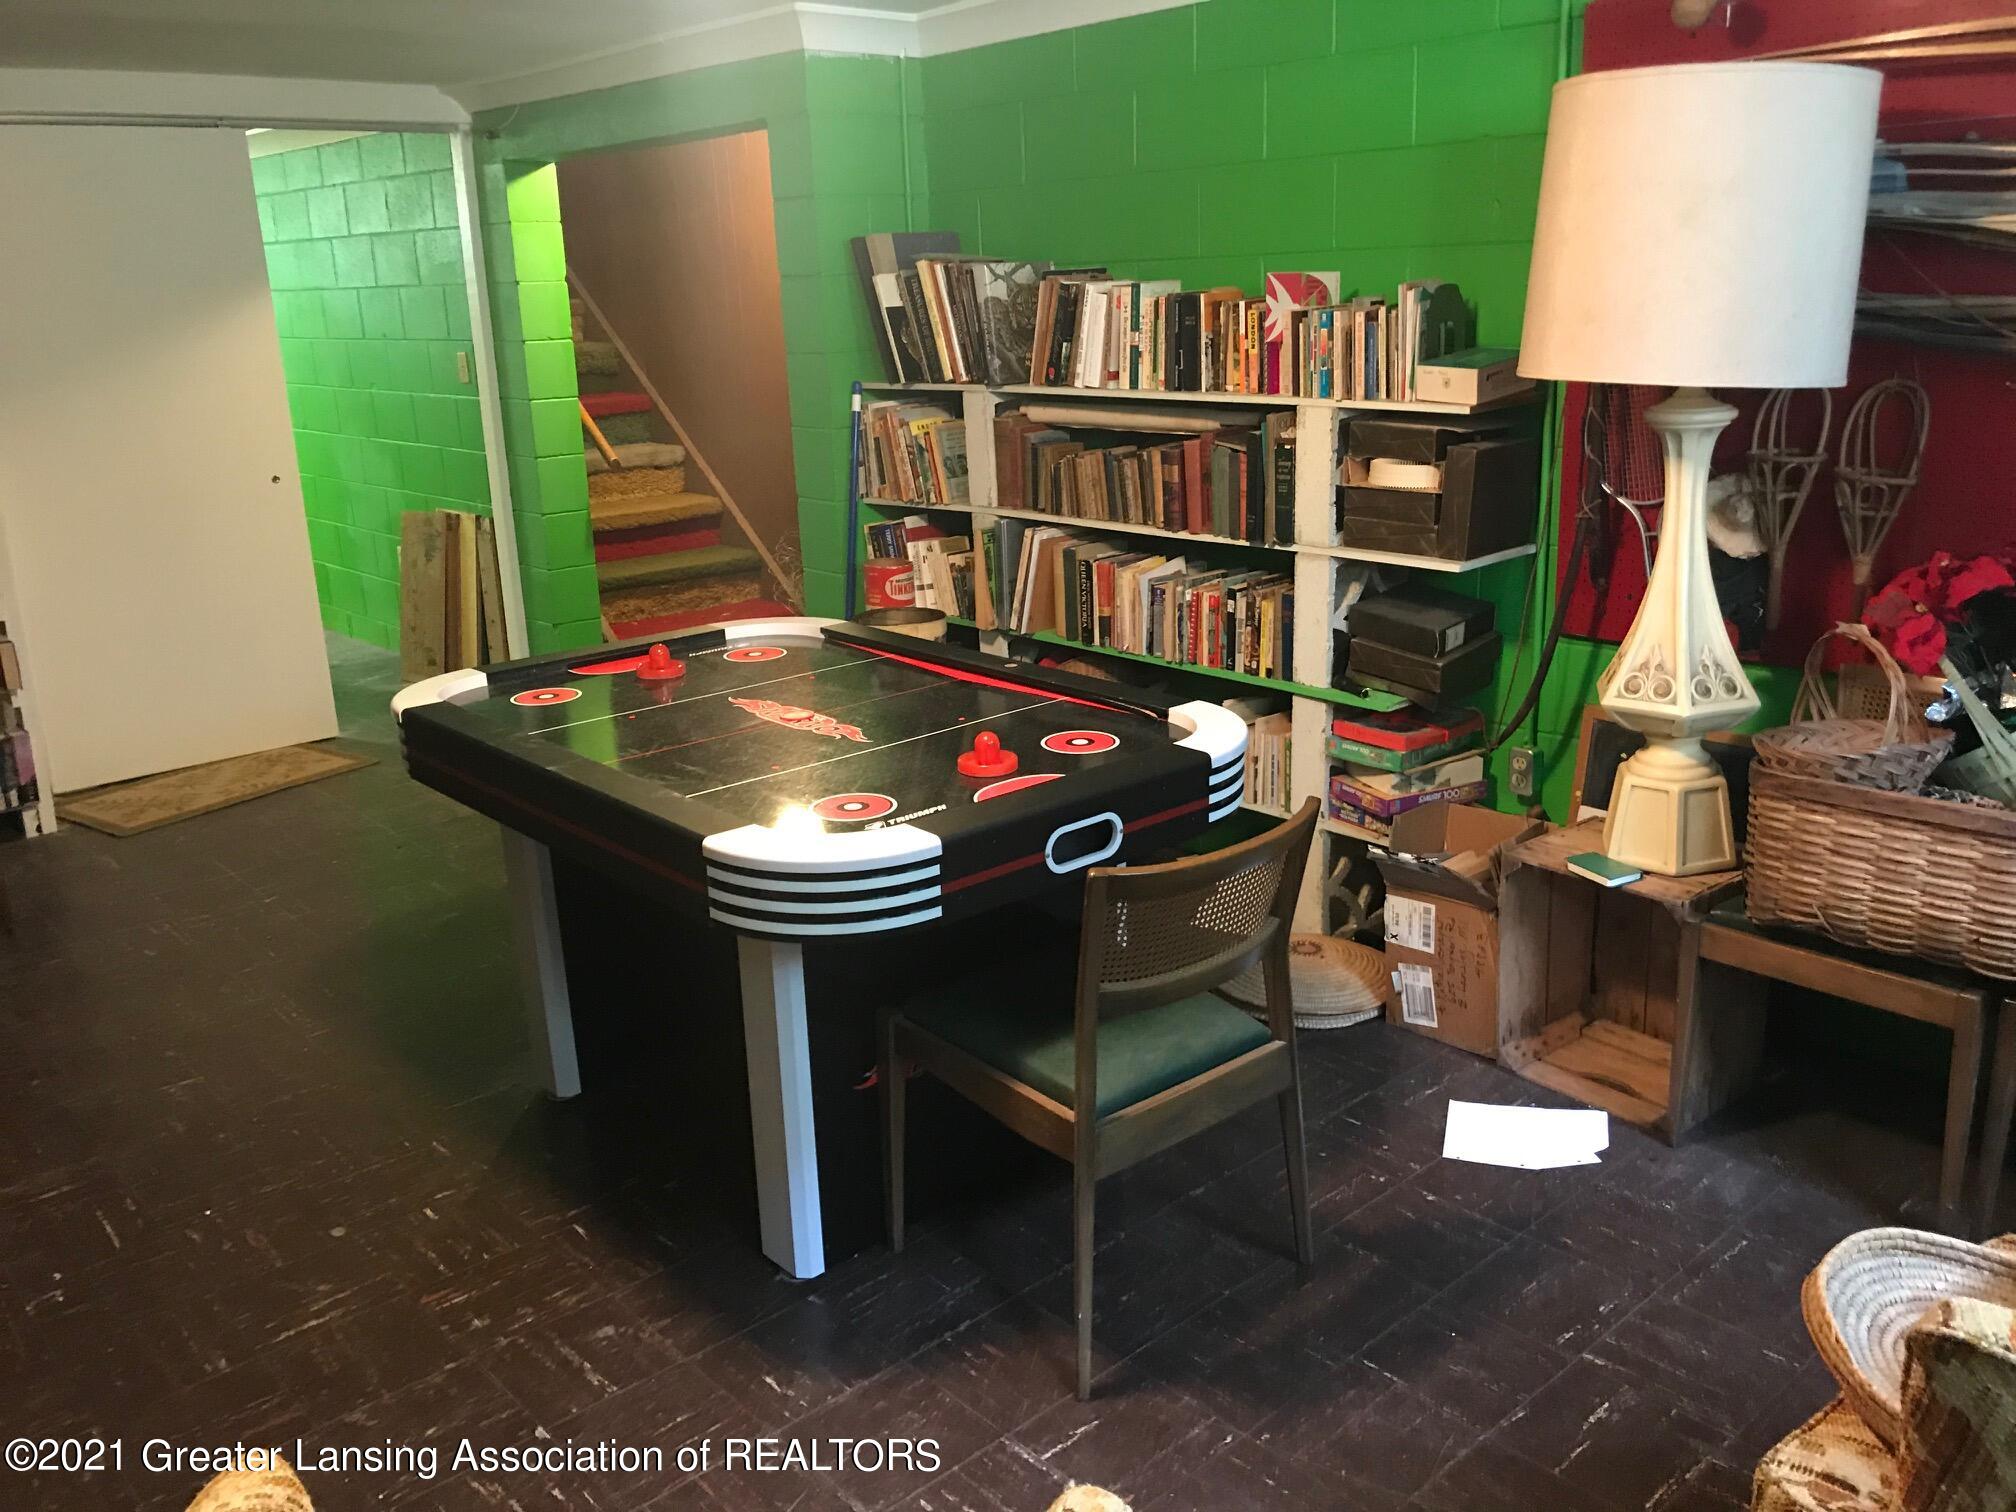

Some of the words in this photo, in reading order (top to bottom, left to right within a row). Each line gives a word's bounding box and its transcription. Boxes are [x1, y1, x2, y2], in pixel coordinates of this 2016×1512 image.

[1418, 792, 1442, 804] SMURF
[1442, 789, 1460, 801] 100
[887, 804, 947, 825] TRIUMPH
